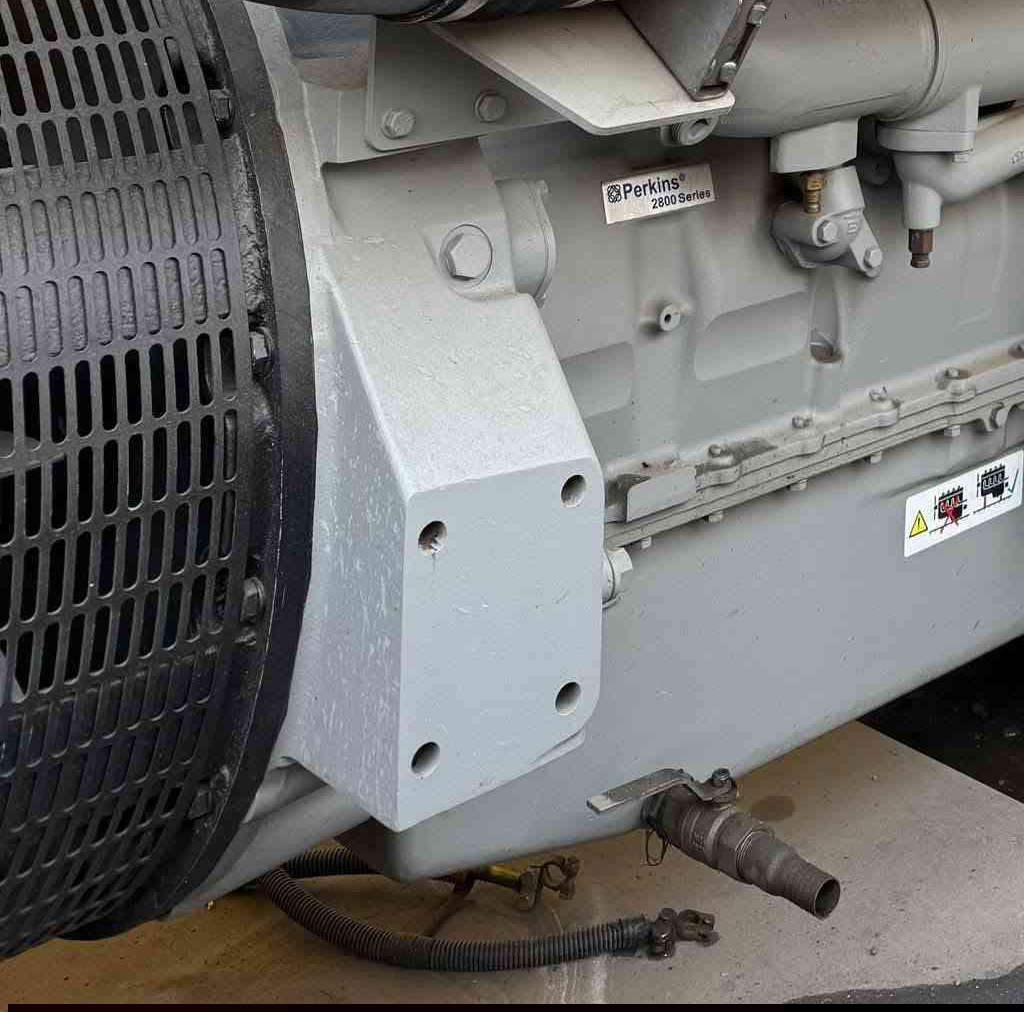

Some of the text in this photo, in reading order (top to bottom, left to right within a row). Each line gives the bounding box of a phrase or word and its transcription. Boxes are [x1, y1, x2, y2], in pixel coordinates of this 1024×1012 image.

[623, 177, 680, 200] Perkins
[651, 189, 711, 210] 2800 Series
